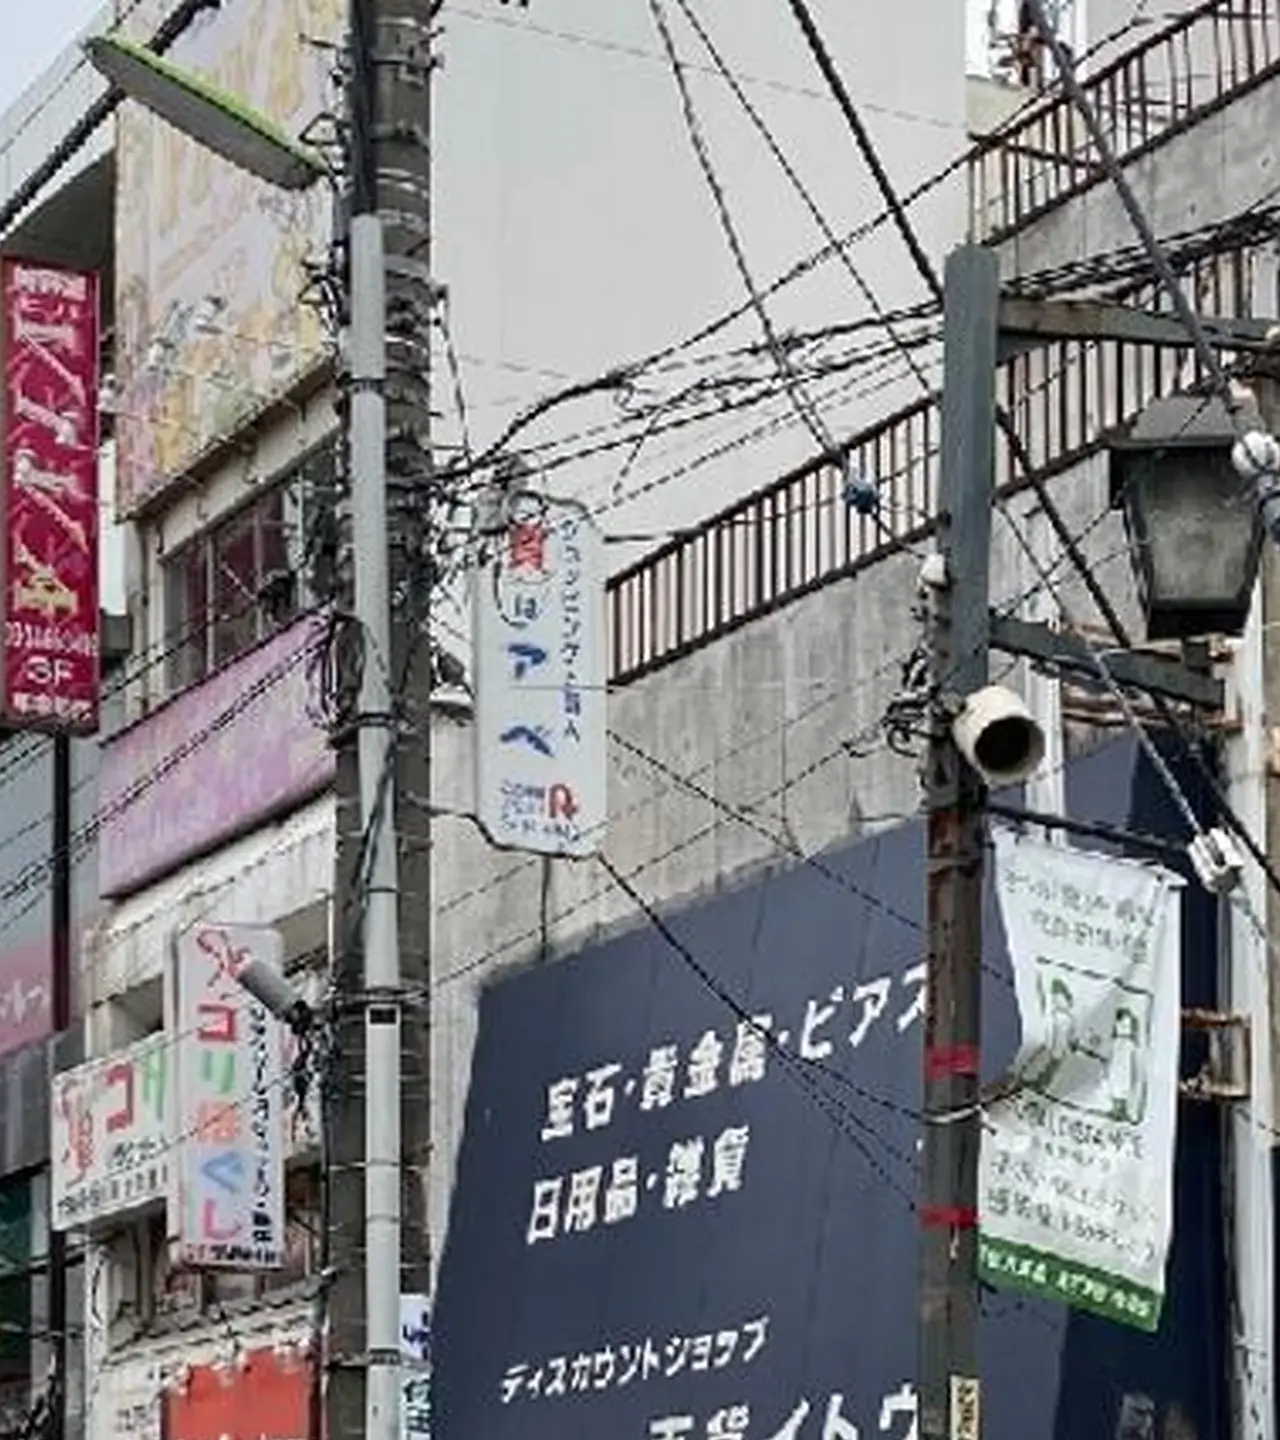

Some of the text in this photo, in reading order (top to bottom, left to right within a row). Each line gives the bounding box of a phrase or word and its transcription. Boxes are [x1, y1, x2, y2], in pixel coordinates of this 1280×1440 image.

[26, 656, 73, 686] 3F
[526, 1124, 750, 1244] 日用品・雑貨
